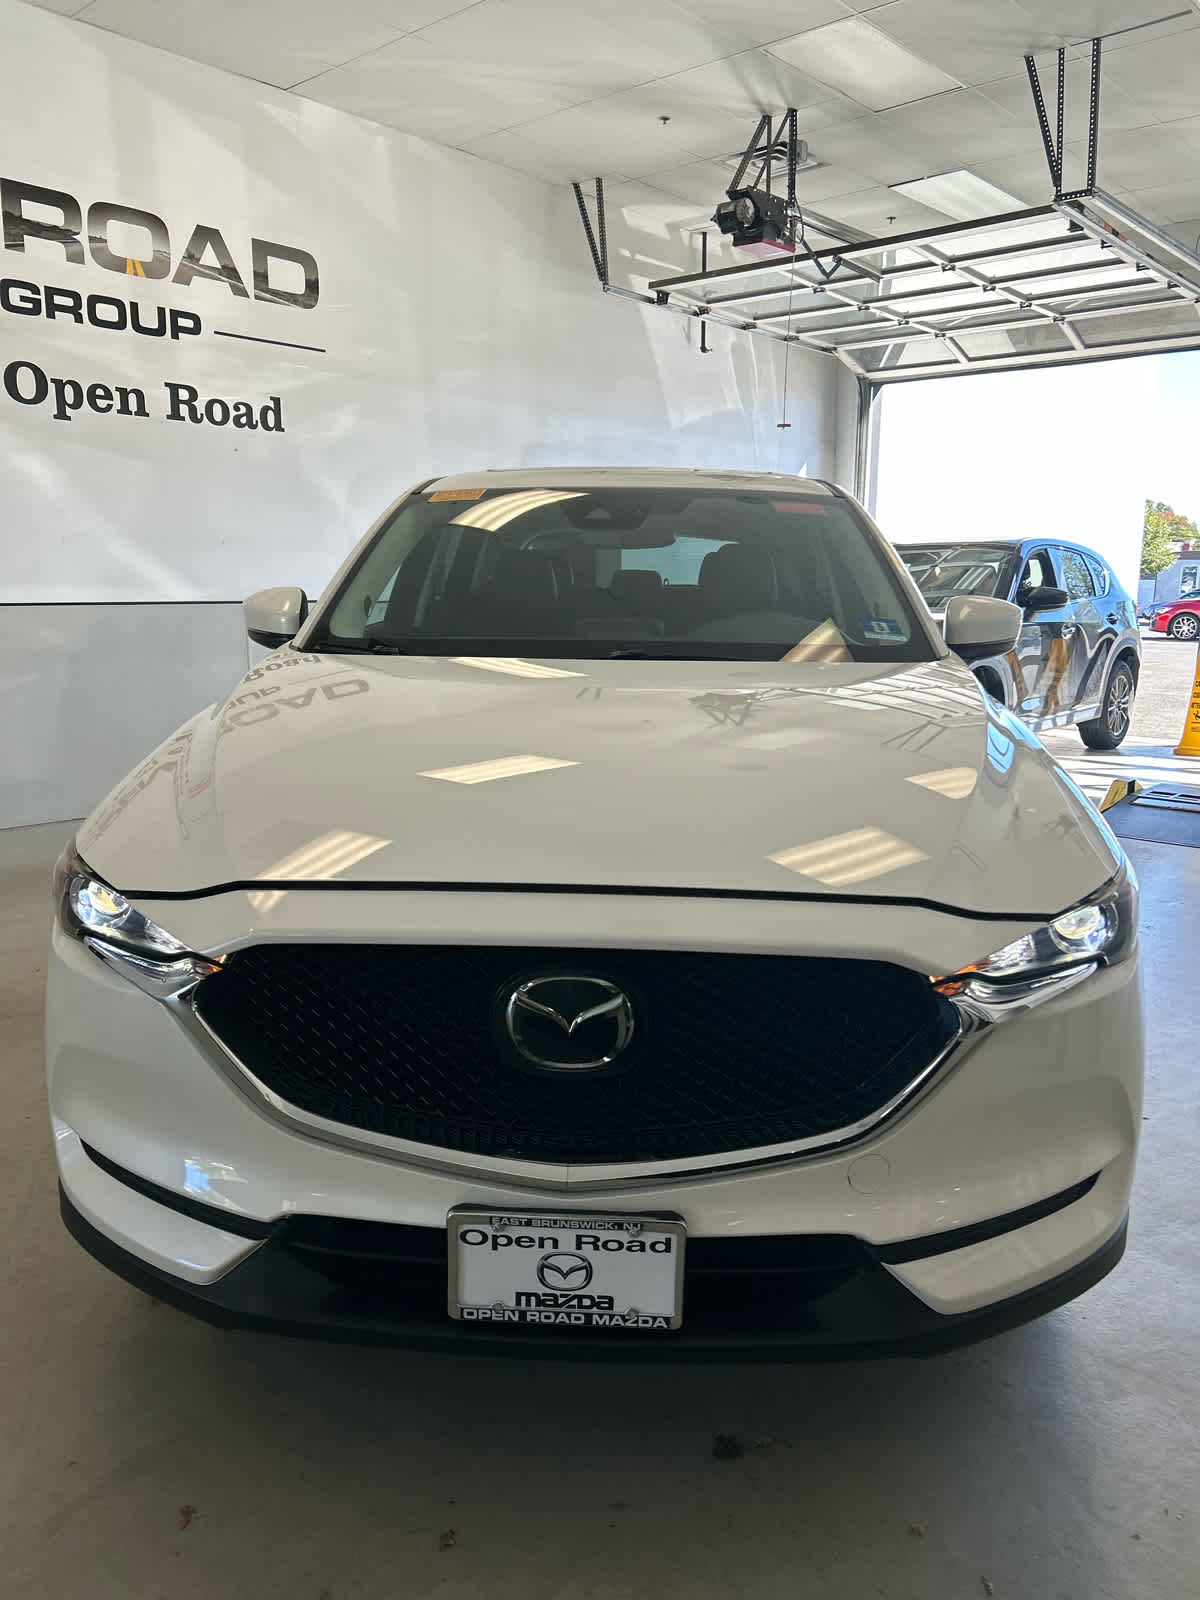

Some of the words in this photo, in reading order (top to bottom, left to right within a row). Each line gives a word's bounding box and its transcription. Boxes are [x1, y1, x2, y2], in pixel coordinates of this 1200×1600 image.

[0, 177, 320, 310] ROAD
[0, 278, 202, 340] GROUP
[3, 360, 149, 421] Open
[164, 382, 285, 433] Road
[492, 1216, 528, 1227] EAST
[532, 1220, 619, 1231] BRUNSWICK,
[623, 1223, 642, 1231] NJ
[459, 1229, 559, 1251] Open
[575, 1233, 672, 1253] Road
[515, 1291, 615, 1311] mazda
[463, 1308, 519, 1321] OPEN
[526, 1311, 585, 1325] ROAD
[592, 1314, 668, 1329] MAZDA
